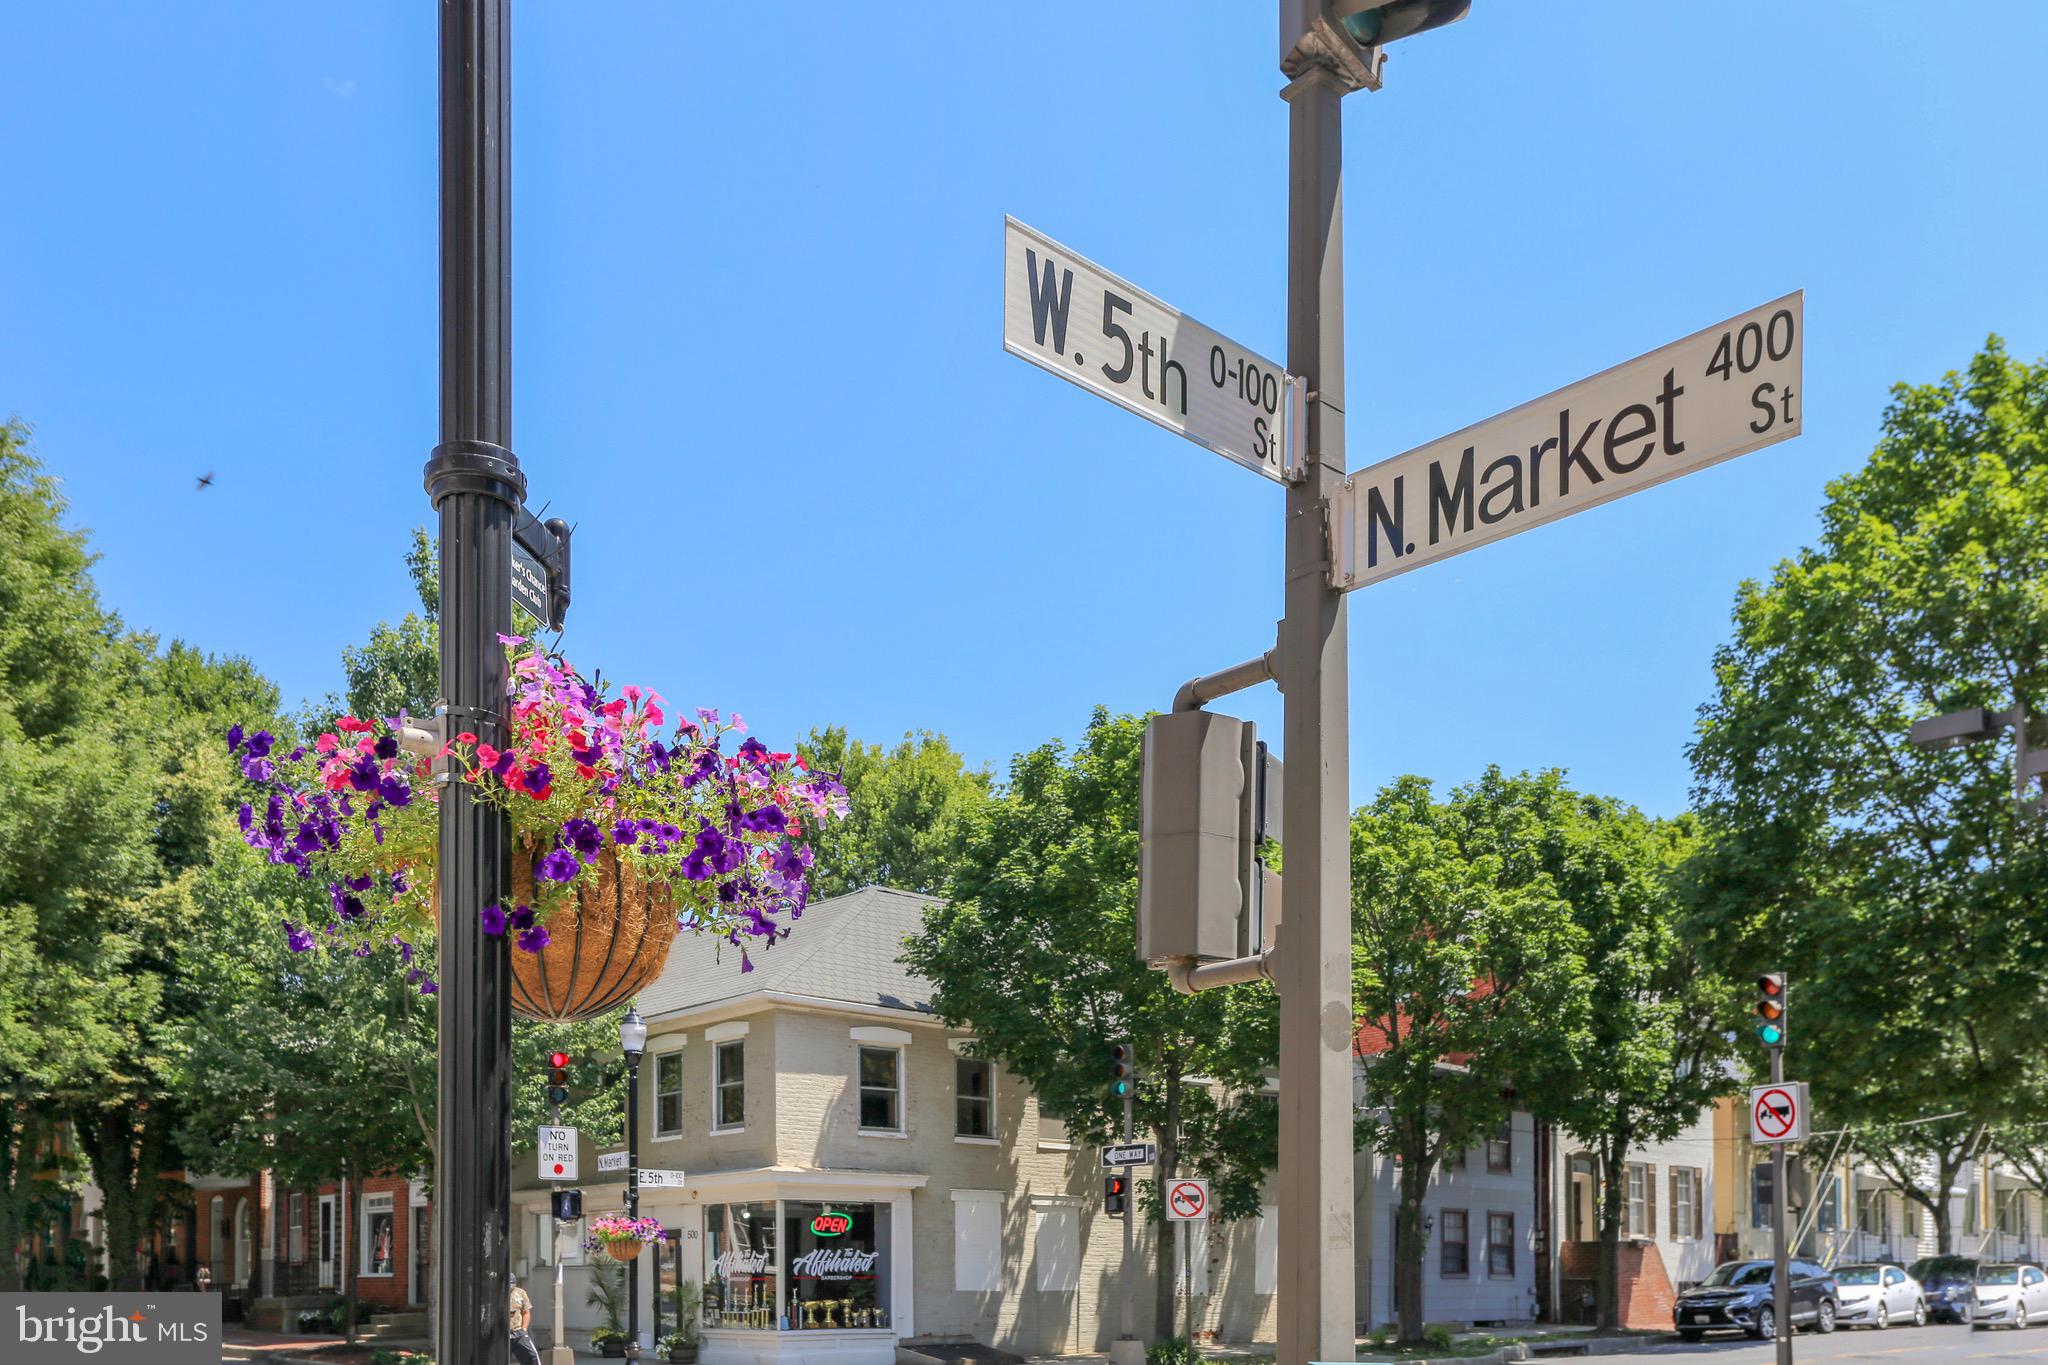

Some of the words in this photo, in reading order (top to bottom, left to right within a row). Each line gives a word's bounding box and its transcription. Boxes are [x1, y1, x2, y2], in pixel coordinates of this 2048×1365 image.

[1026, 247, 1084, 366] W.
[1101, 289, 1188, 417] 5th
[1210, 345, 1278, 415] 0-100
[1749, 382, 1794, 434] St
[1253, 417, 1277, 466] St
[1367, 474, 1416, 569] N.
[1429, 367, 1686, 546] Market
[1705, 309, 1795, 382] 400
[512, 576, 529, 598] arden
[549, 1131, 566, 1141] NO
[547, 1142, 569, 1151] TURN
[1114, 1151, 1126, 1160] ONE
[1129, 1150, 1141, 1159] WAY
[543, 1153, 554, 1162] ON
[558, 1154, 574, 1162] RED
[648, 1172, 663, 1184] 5th
[814, 1216, 848, 1233] OPEN
[792, 1249, 880, 1277] Affiliated
